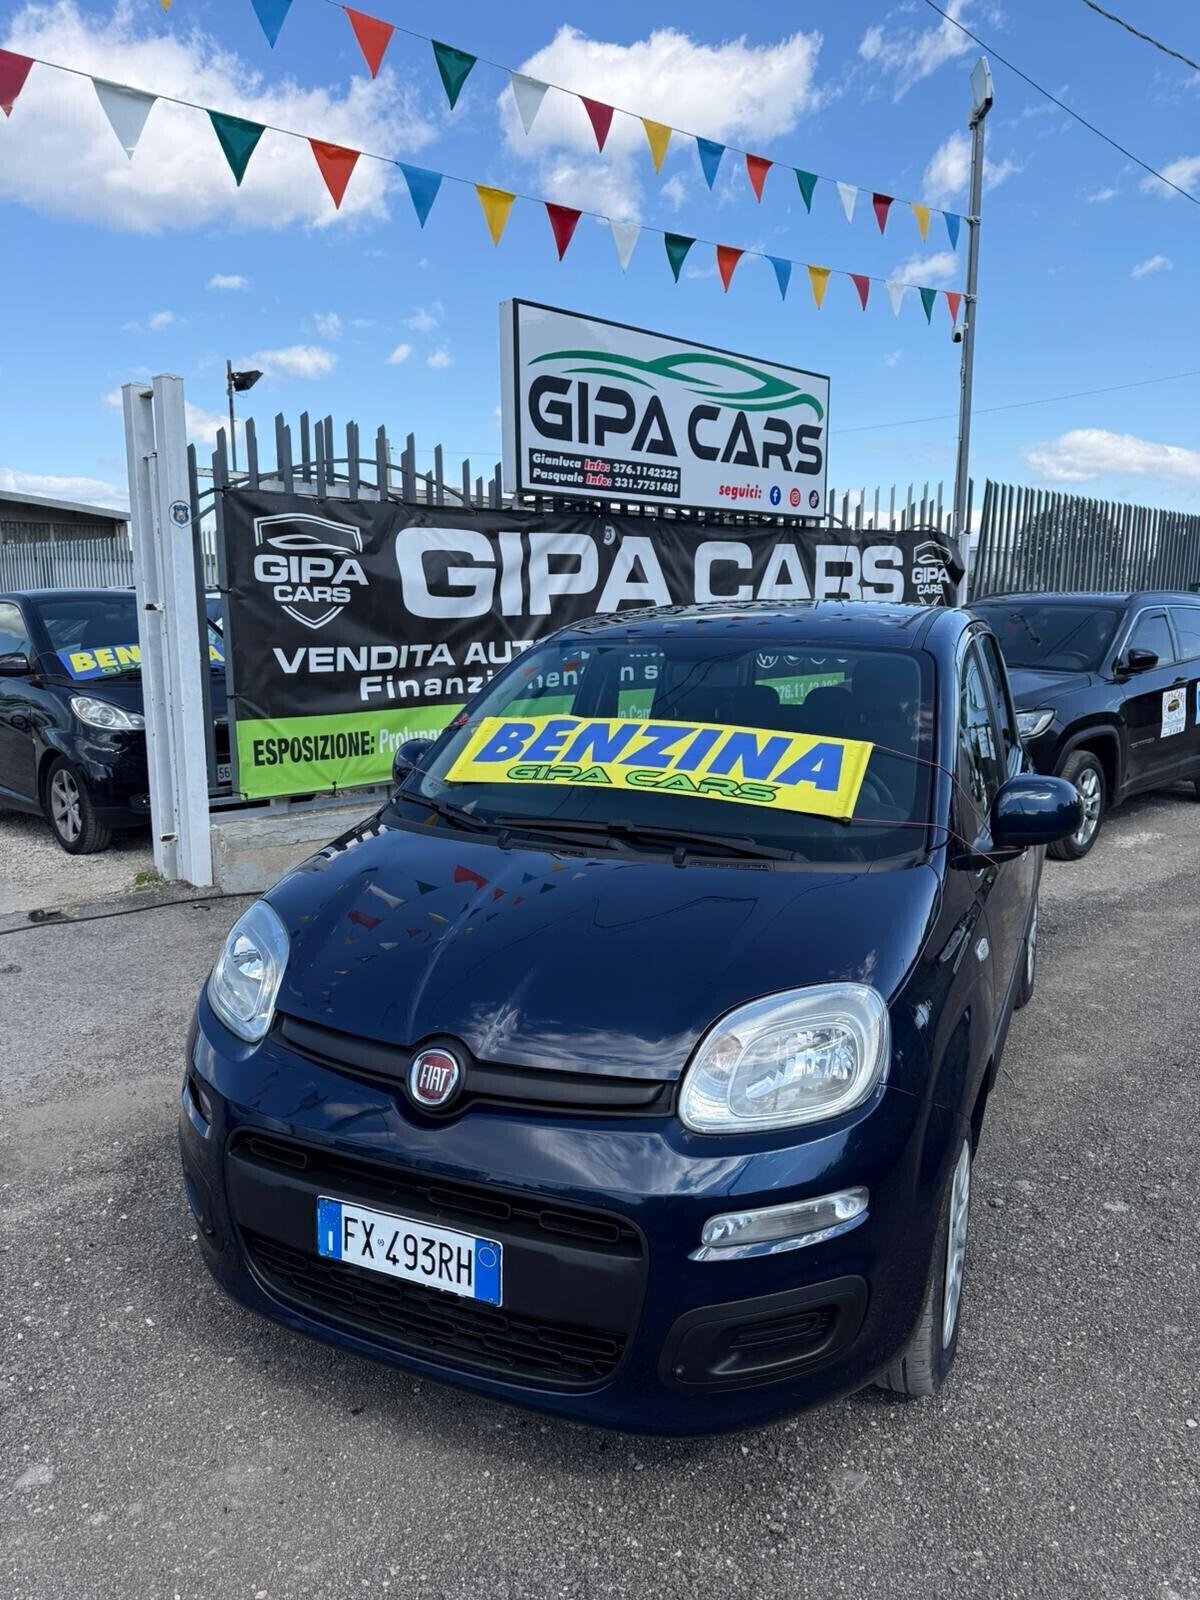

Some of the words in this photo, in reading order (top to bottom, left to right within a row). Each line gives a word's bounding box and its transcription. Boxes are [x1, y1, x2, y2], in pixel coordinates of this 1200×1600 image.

[528, 375, 678, 457] GIPA
[688, 404, 823, 476] CARS
[532, 453, 582, 469] Gianluca
[584, 458, 611, 473] Info:
[613, 463, 678, 480] 376.1142322
[532, 468, 584, 483] Pasquale
[586, 473, 612, 487] Info:
[614, 477, 679, 493] 331.7751481
[719, 483, 762, 500] seguici:
[253, 554, 369, 586] GIPA
[395, 527, 673, 619] GIPA
[694, 541, 905, 601] CARS
[912, 567, 951, 584] GIPA
[273, 586, 351, 603] CARS
[917, 584, 944, 595] CARS
[272, 643, 457, 674] VENDITA
[252, 731, 375, 767] ESPOSIZIONE:
[473, 719, 844, 792] BENZINA
[506, 764, 612, 785] GIPA
[624, 771, 782, 803] CARS
[419, 1063, 450, 1092] FIAT
[343, 1216, 375, 1260] FX
[385, 1230, 473, 1287] 493RH
